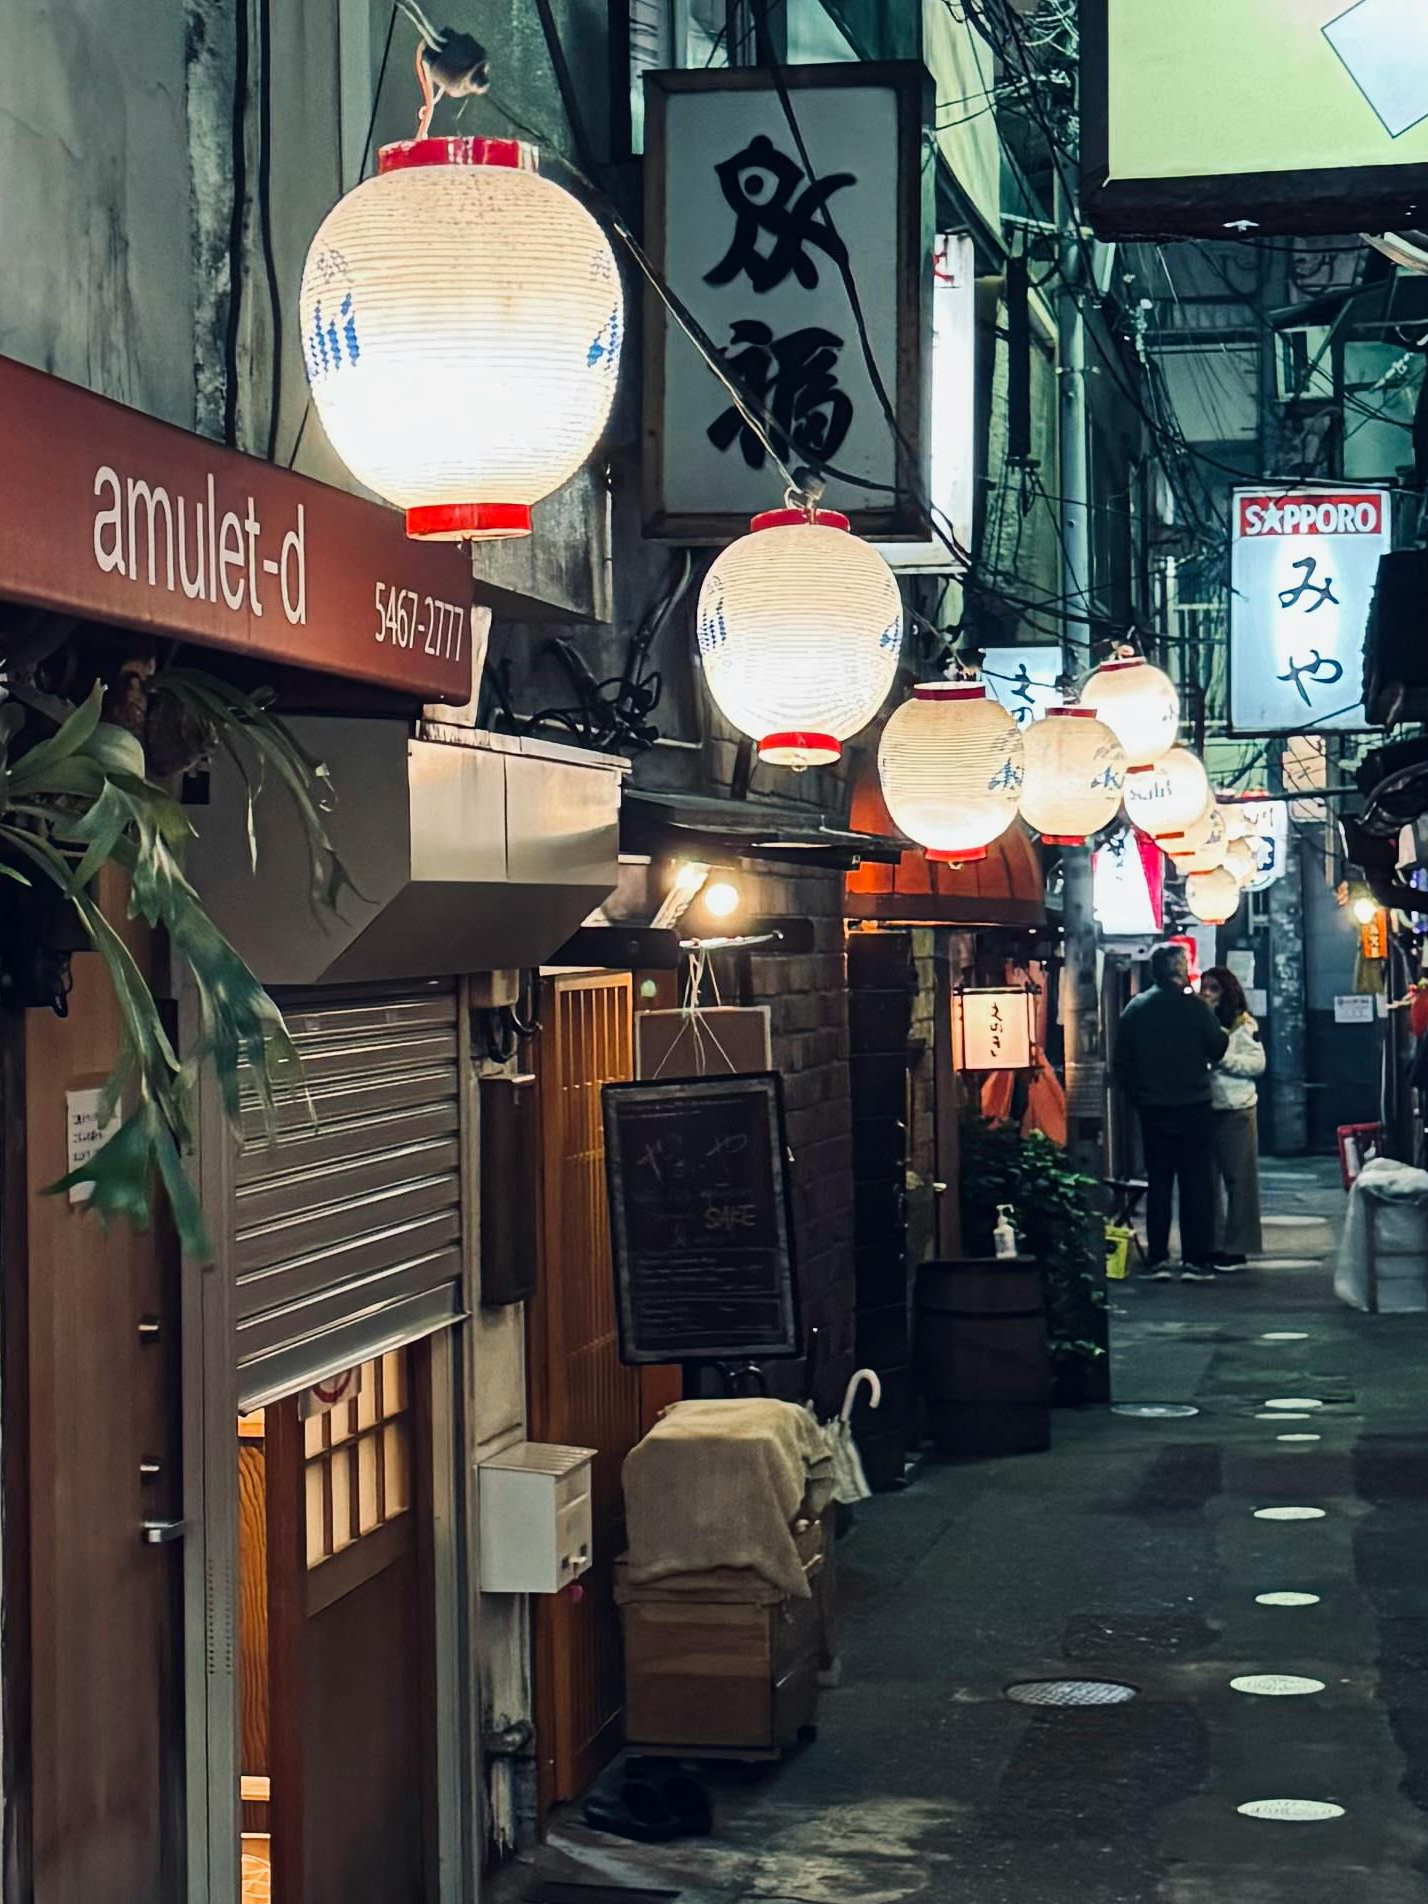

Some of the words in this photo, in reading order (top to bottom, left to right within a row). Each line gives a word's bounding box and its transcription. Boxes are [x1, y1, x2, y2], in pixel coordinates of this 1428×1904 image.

[92, 465, 308, 626] amulet-d
[1244, 501, 1378, 535] SAPPORO
[374, 581, 465, 662] 5467-2777
[1276, 556, 1343, 708] みや
